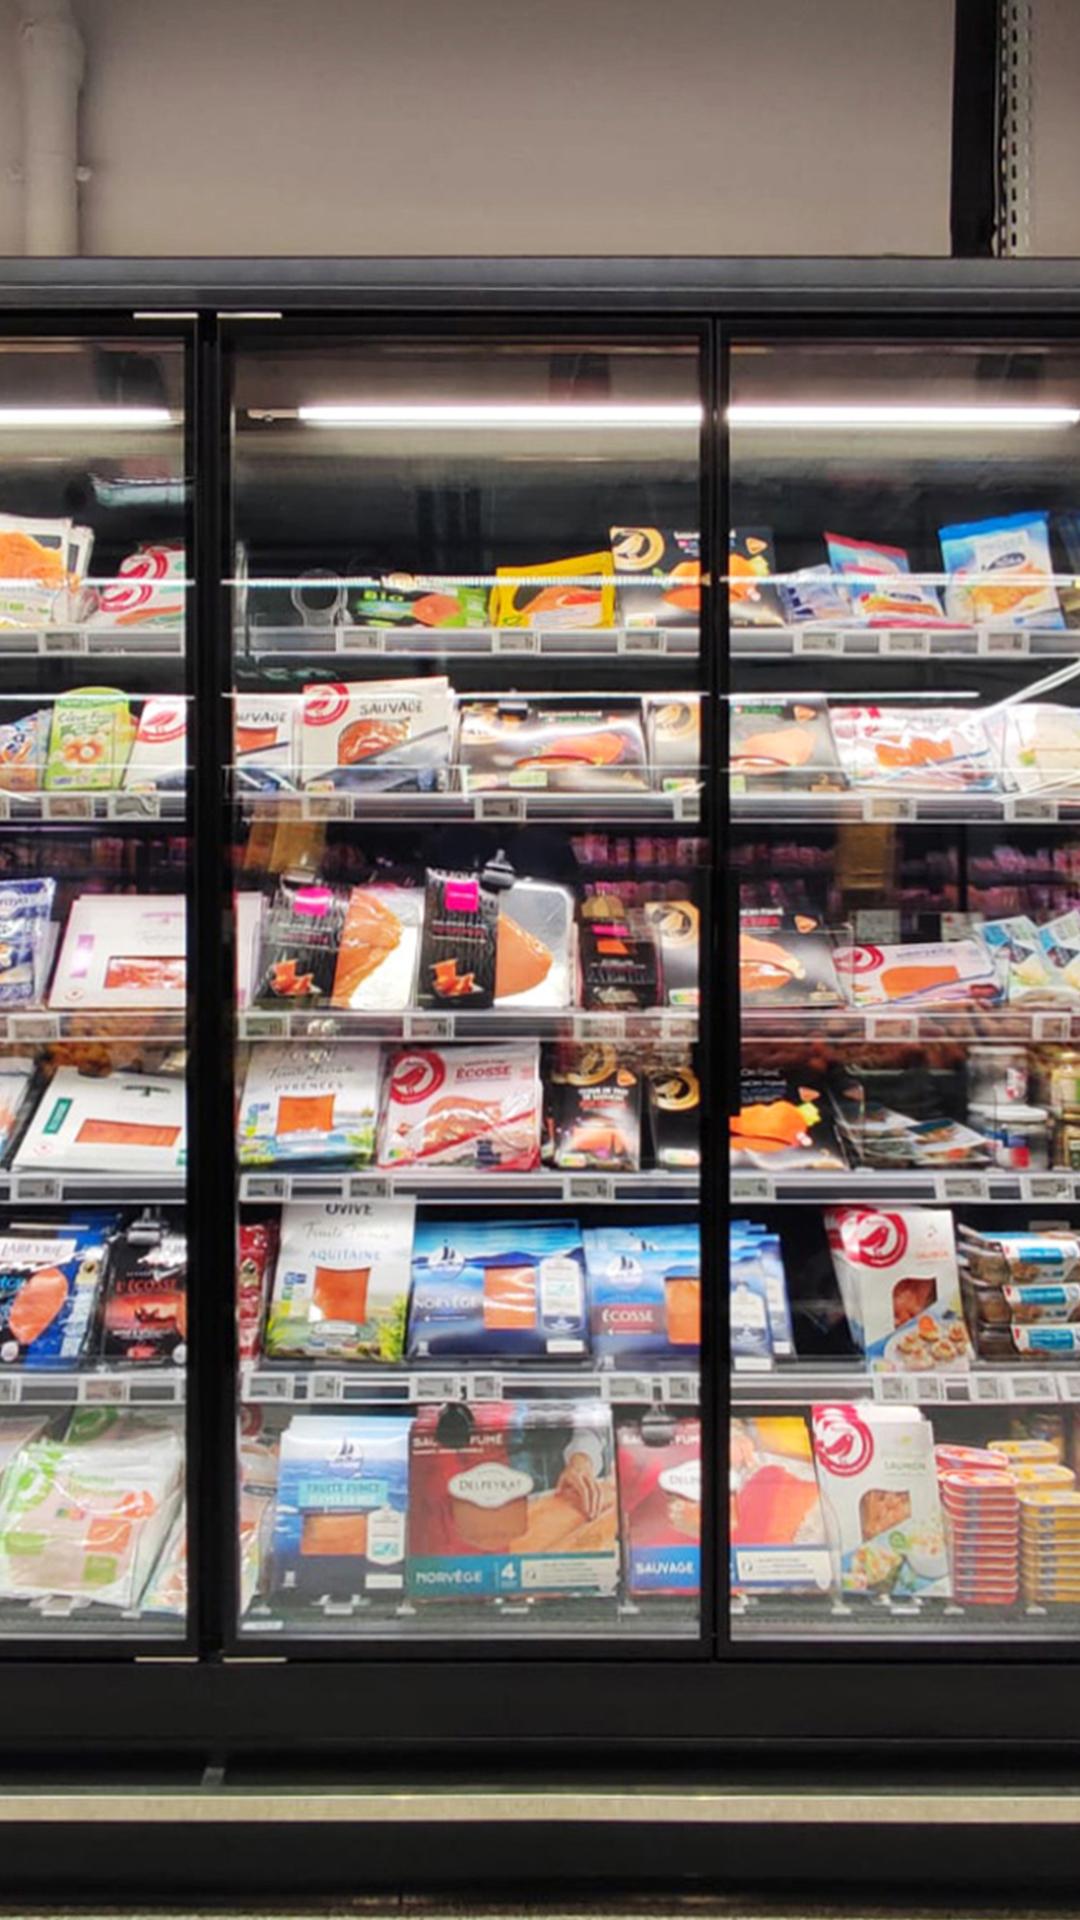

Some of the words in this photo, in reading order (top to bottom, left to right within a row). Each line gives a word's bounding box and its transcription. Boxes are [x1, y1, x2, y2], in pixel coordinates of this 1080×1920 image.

[359, 700, 424, 716] SAUVAGE
[309, 1248, 382, 1261] AQUITAINE
[601, 1308, 655, 1323] ÉCOSSE
[470, 1433, 503, 1445] FUMÉ
[458, 1479, 522, 1492] DELPEYRAT
[501, 1561, 516, 1579] 4
[635, 1562, 694, 1575] SAUVAGE
